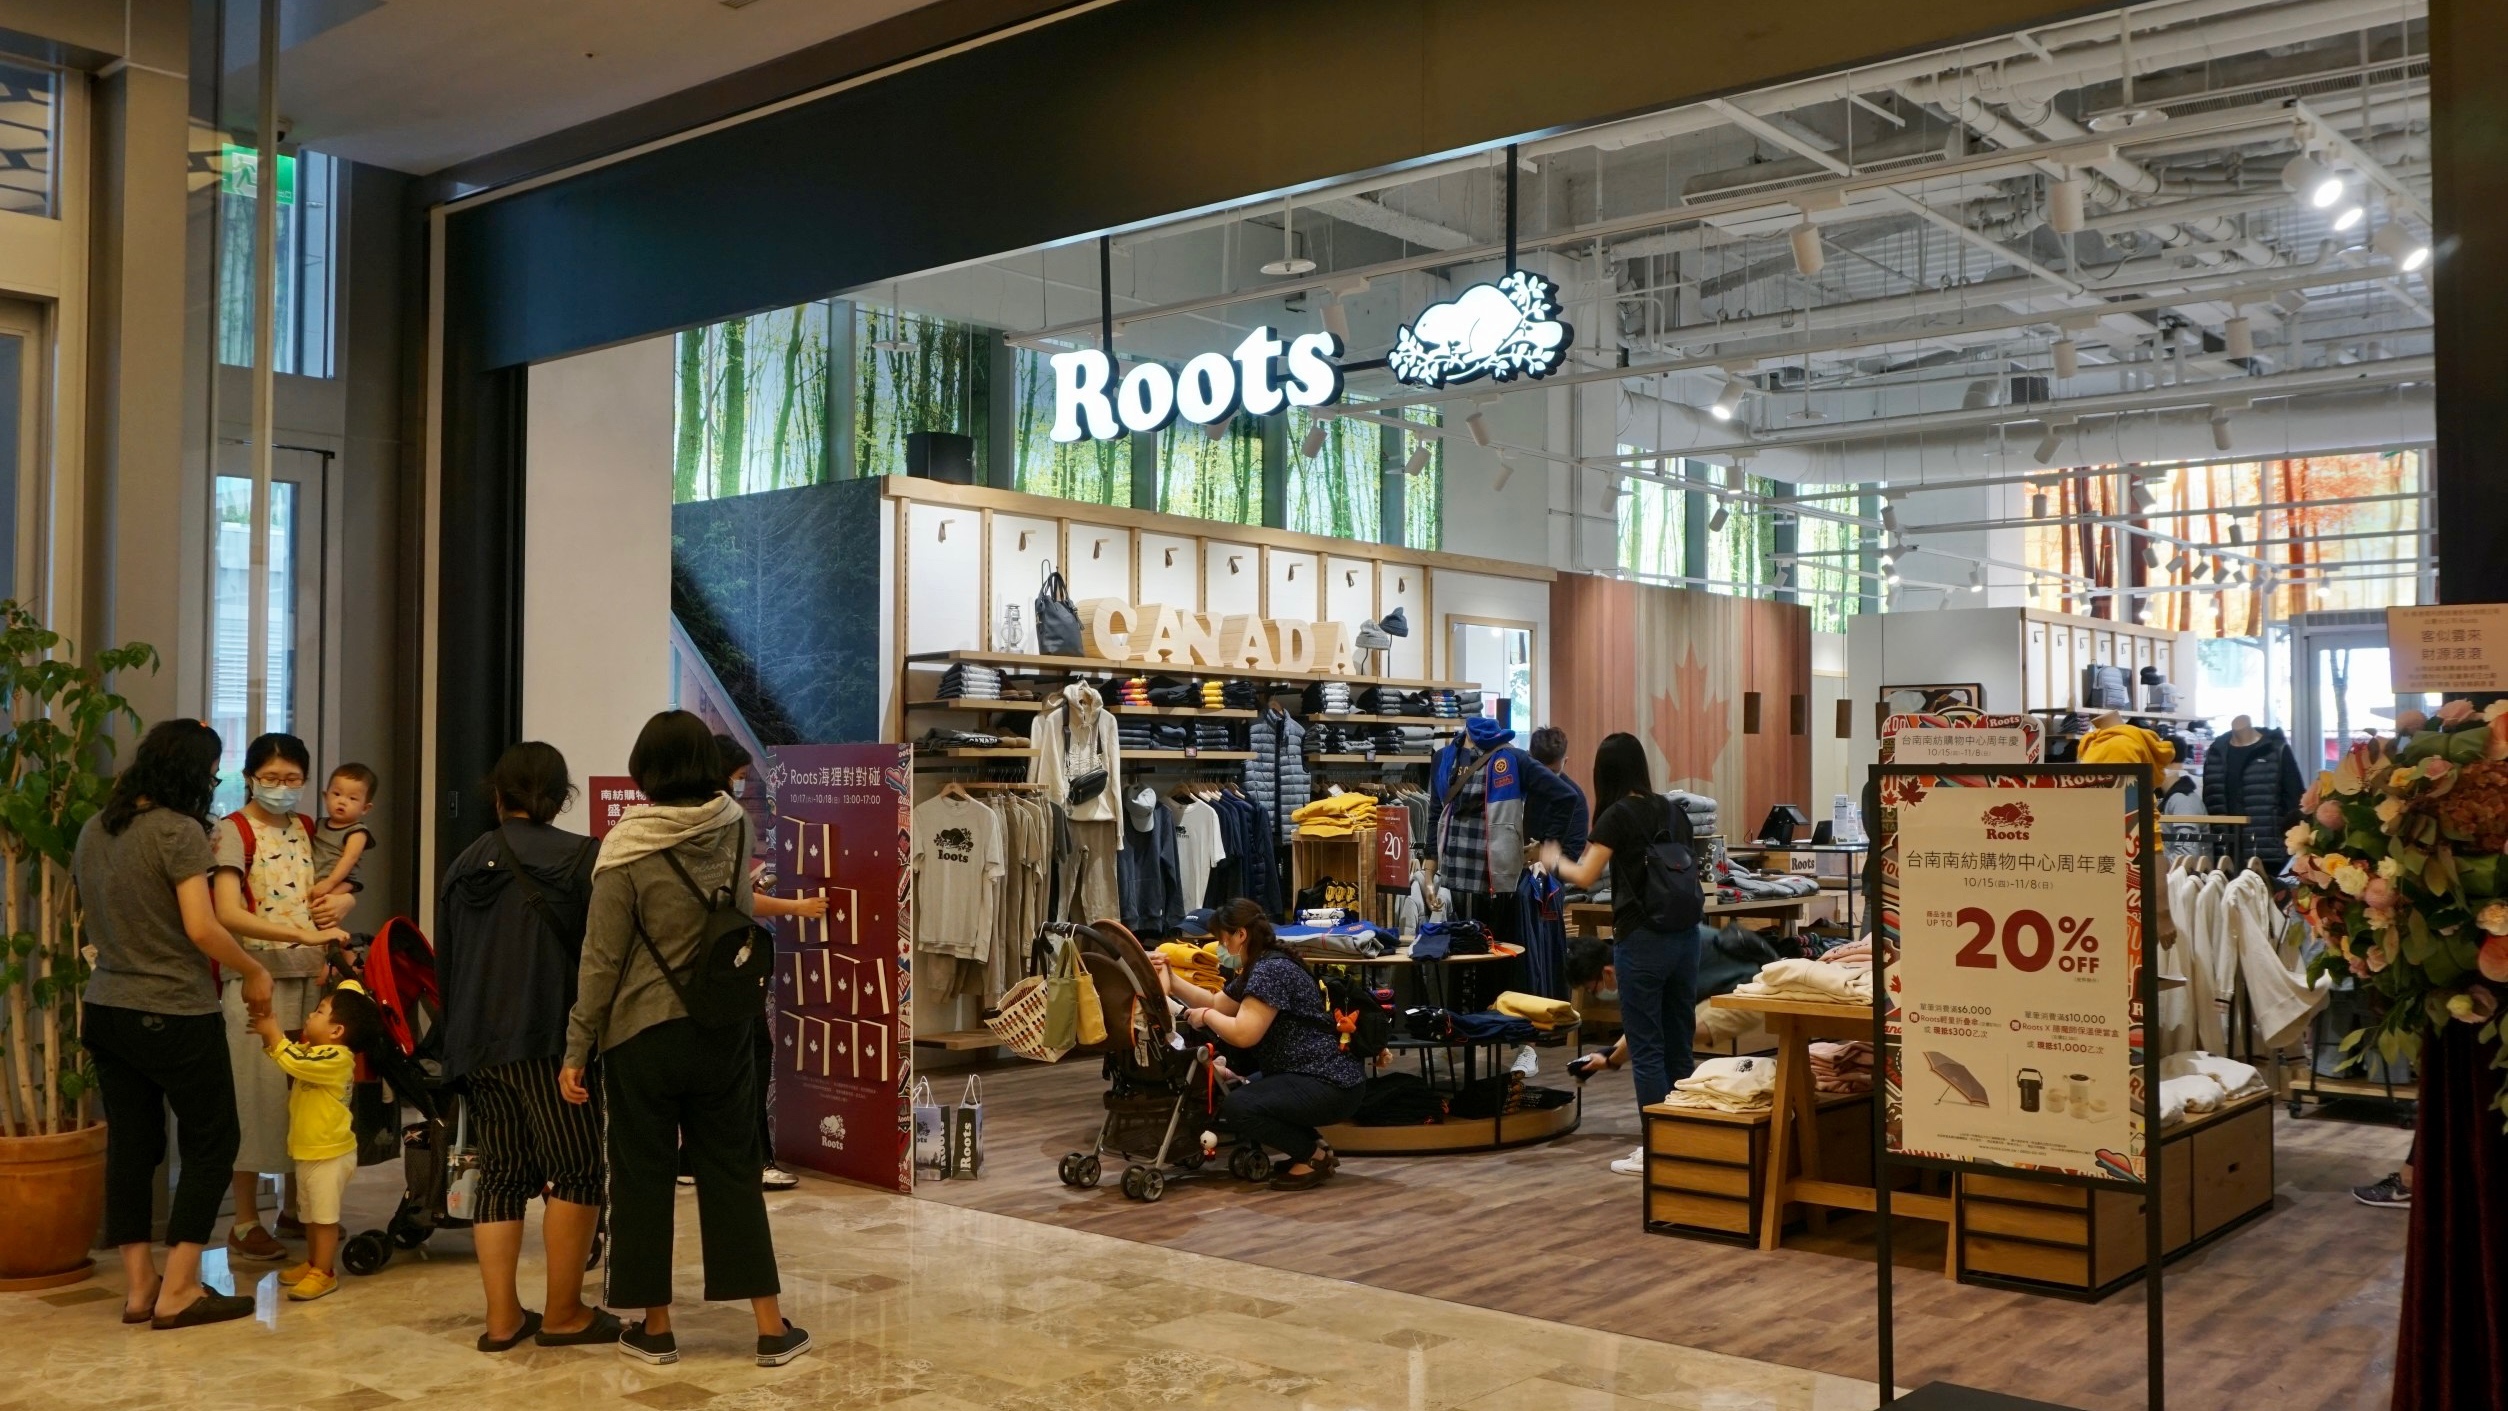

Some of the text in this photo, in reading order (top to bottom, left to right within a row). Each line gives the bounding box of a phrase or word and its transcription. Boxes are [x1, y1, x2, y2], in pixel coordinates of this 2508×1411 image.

[1050, 325, 1340, 443] Roots
[1090, 597, 1356, 675] CANADA
[1988, 715, 2020, 727] Roots
[1902, 735, 2019, 747] 台南南紡購物中心周年慶
[790, 766, 881, 787] Roots海狸對對碰
[843, 794, 881, 805] 13:00-17:00
[1986, 828, 2030, 841] Roots
[1791, 857, 1815, 871] Roots
[1906, 850, 2116, 875] 台南南紡購物中心周年慶
[1926, 919, 1953, 928] UP TO
[2058, 955, 2100, 974] OFF
[821, 1137, 844, 1150] Roots
[960, 1122, 972, 1169] Roots
